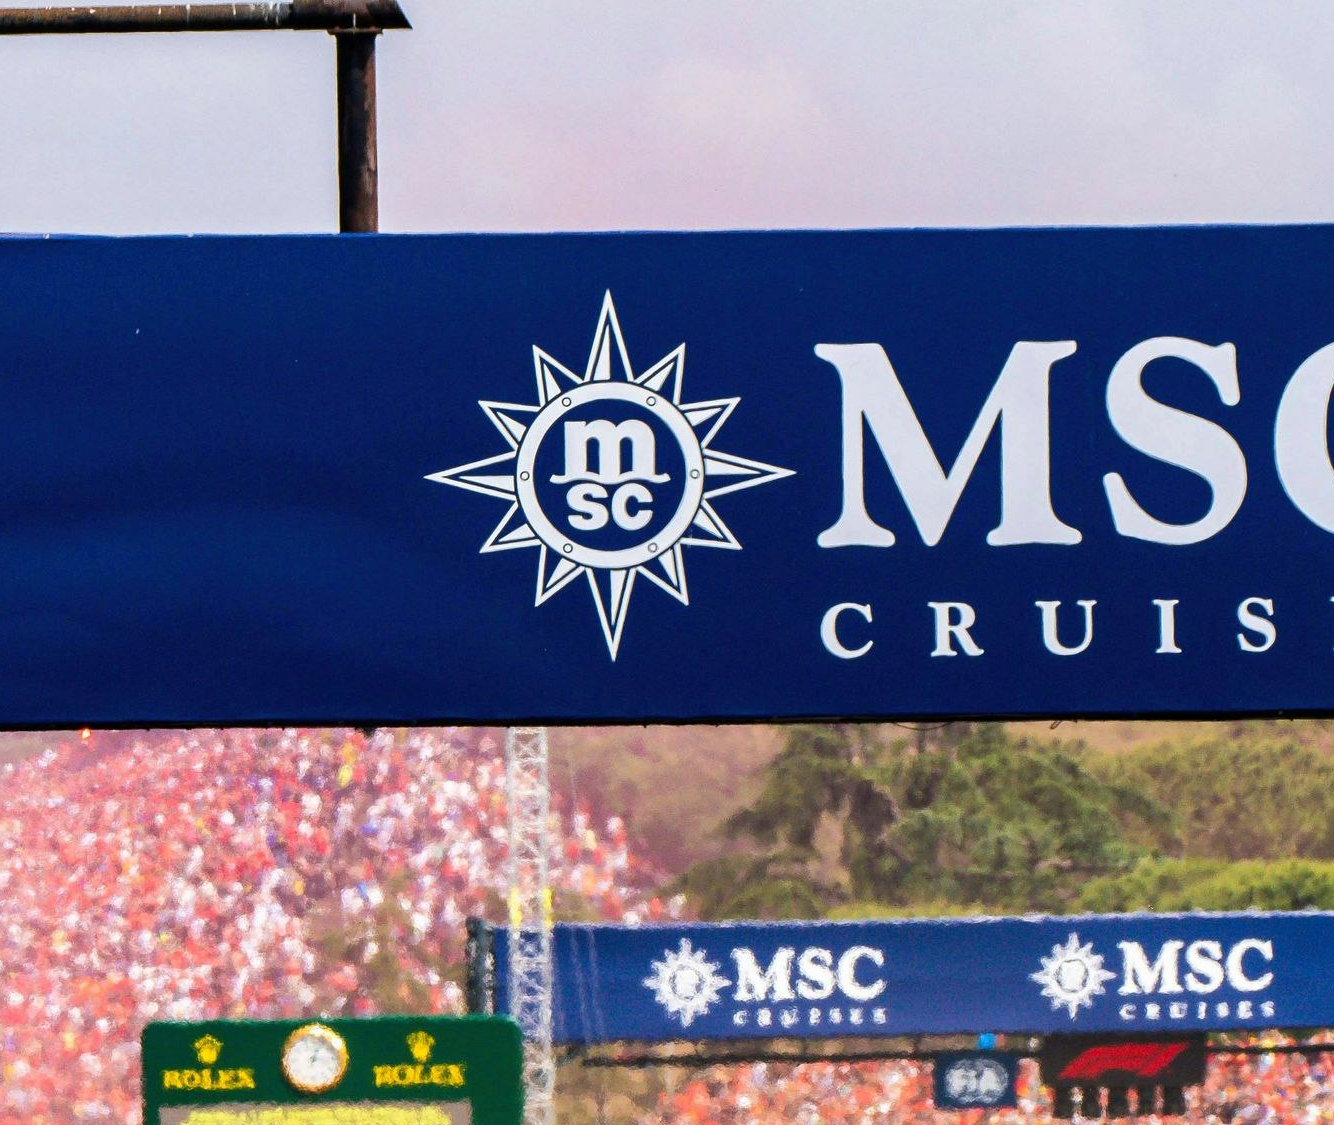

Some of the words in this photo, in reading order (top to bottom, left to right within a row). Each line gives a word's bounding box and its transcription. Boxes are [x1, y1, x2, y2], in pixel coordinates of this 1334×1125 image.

[730, 945, 888, 1002] MSC
[1117, 938, 1275, 996] MSC
[162, 1067, 256, 1090] ROLEX
[373, 1063, 465, 1087] ROLEX
